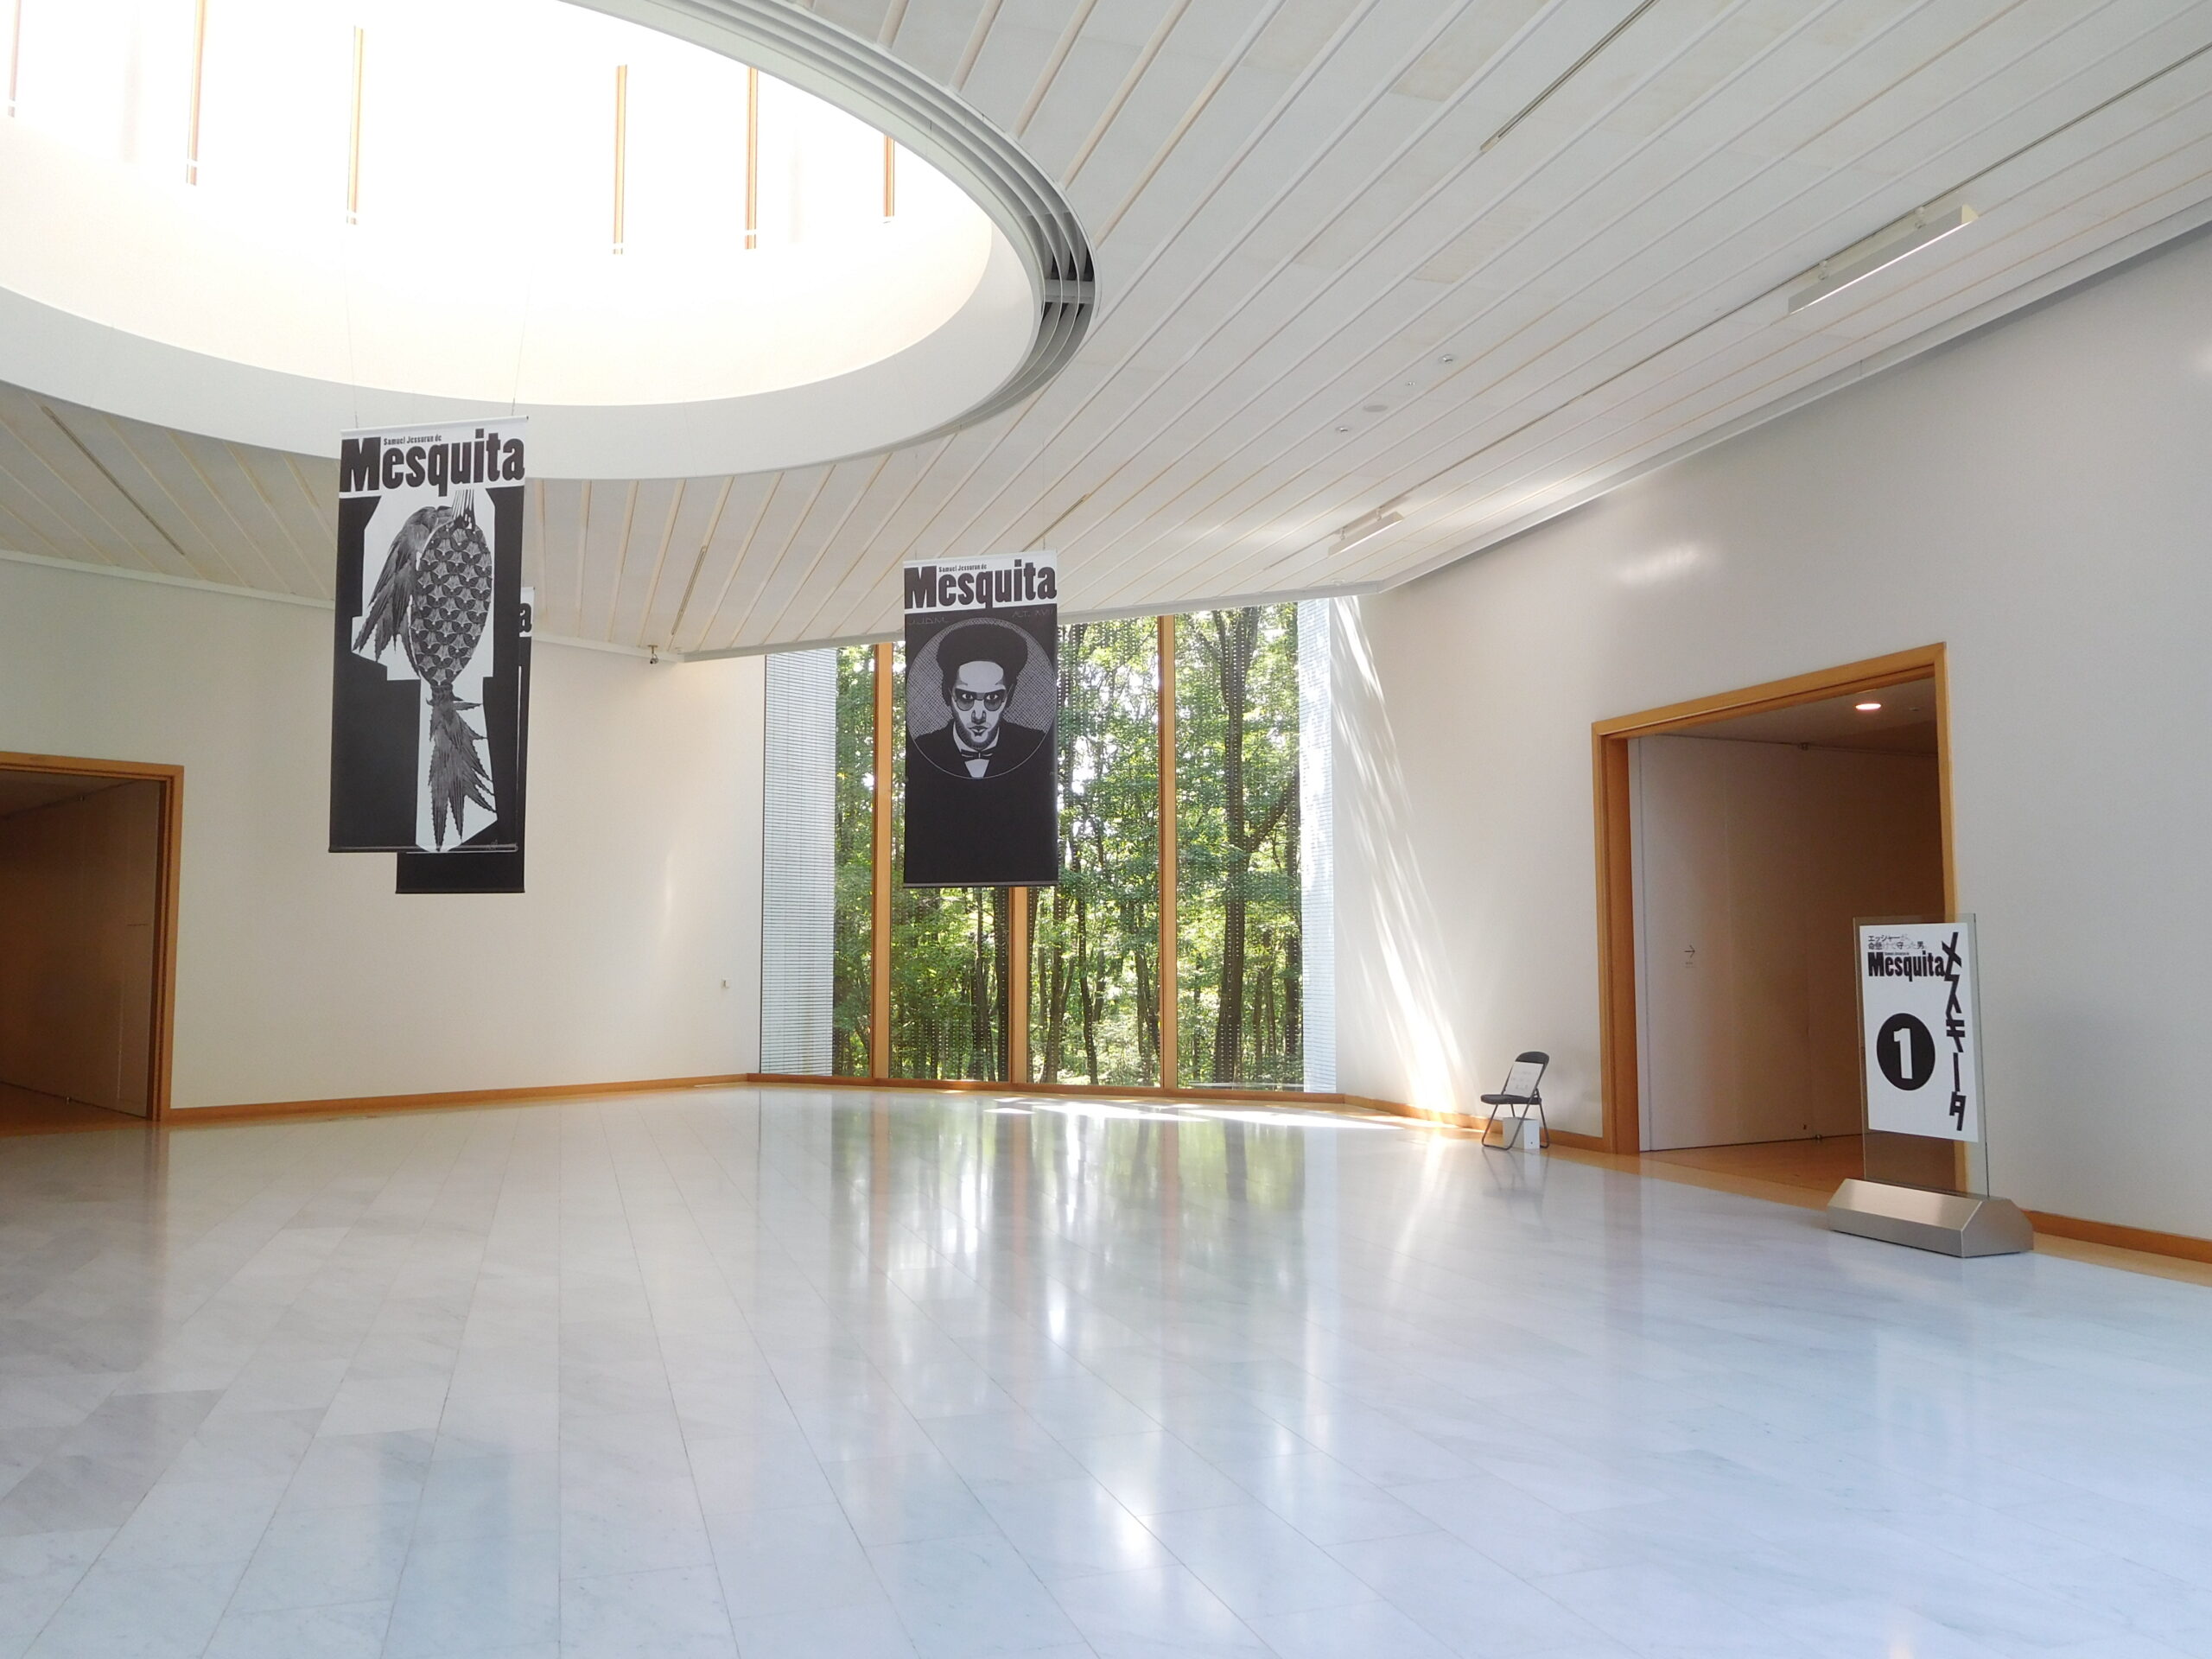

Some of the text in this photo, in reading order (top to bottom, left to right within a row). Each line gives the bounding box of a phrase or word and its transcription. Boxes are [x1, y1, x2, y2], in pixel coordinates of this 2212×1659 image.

[340, 428, 525, 498] Mesquita
[384, 436, 406, 446] Samuel
[435, 434, 442, 442] de
[904, 559, 1058, 610] Mesquita
[938, 564, 957, 573] Samuel
[1867, 950, 1946, 982] Mesquita
[1893, 1027, 1913, 1079] 1
[1941, 931, 1967, 1131] メスキータ
